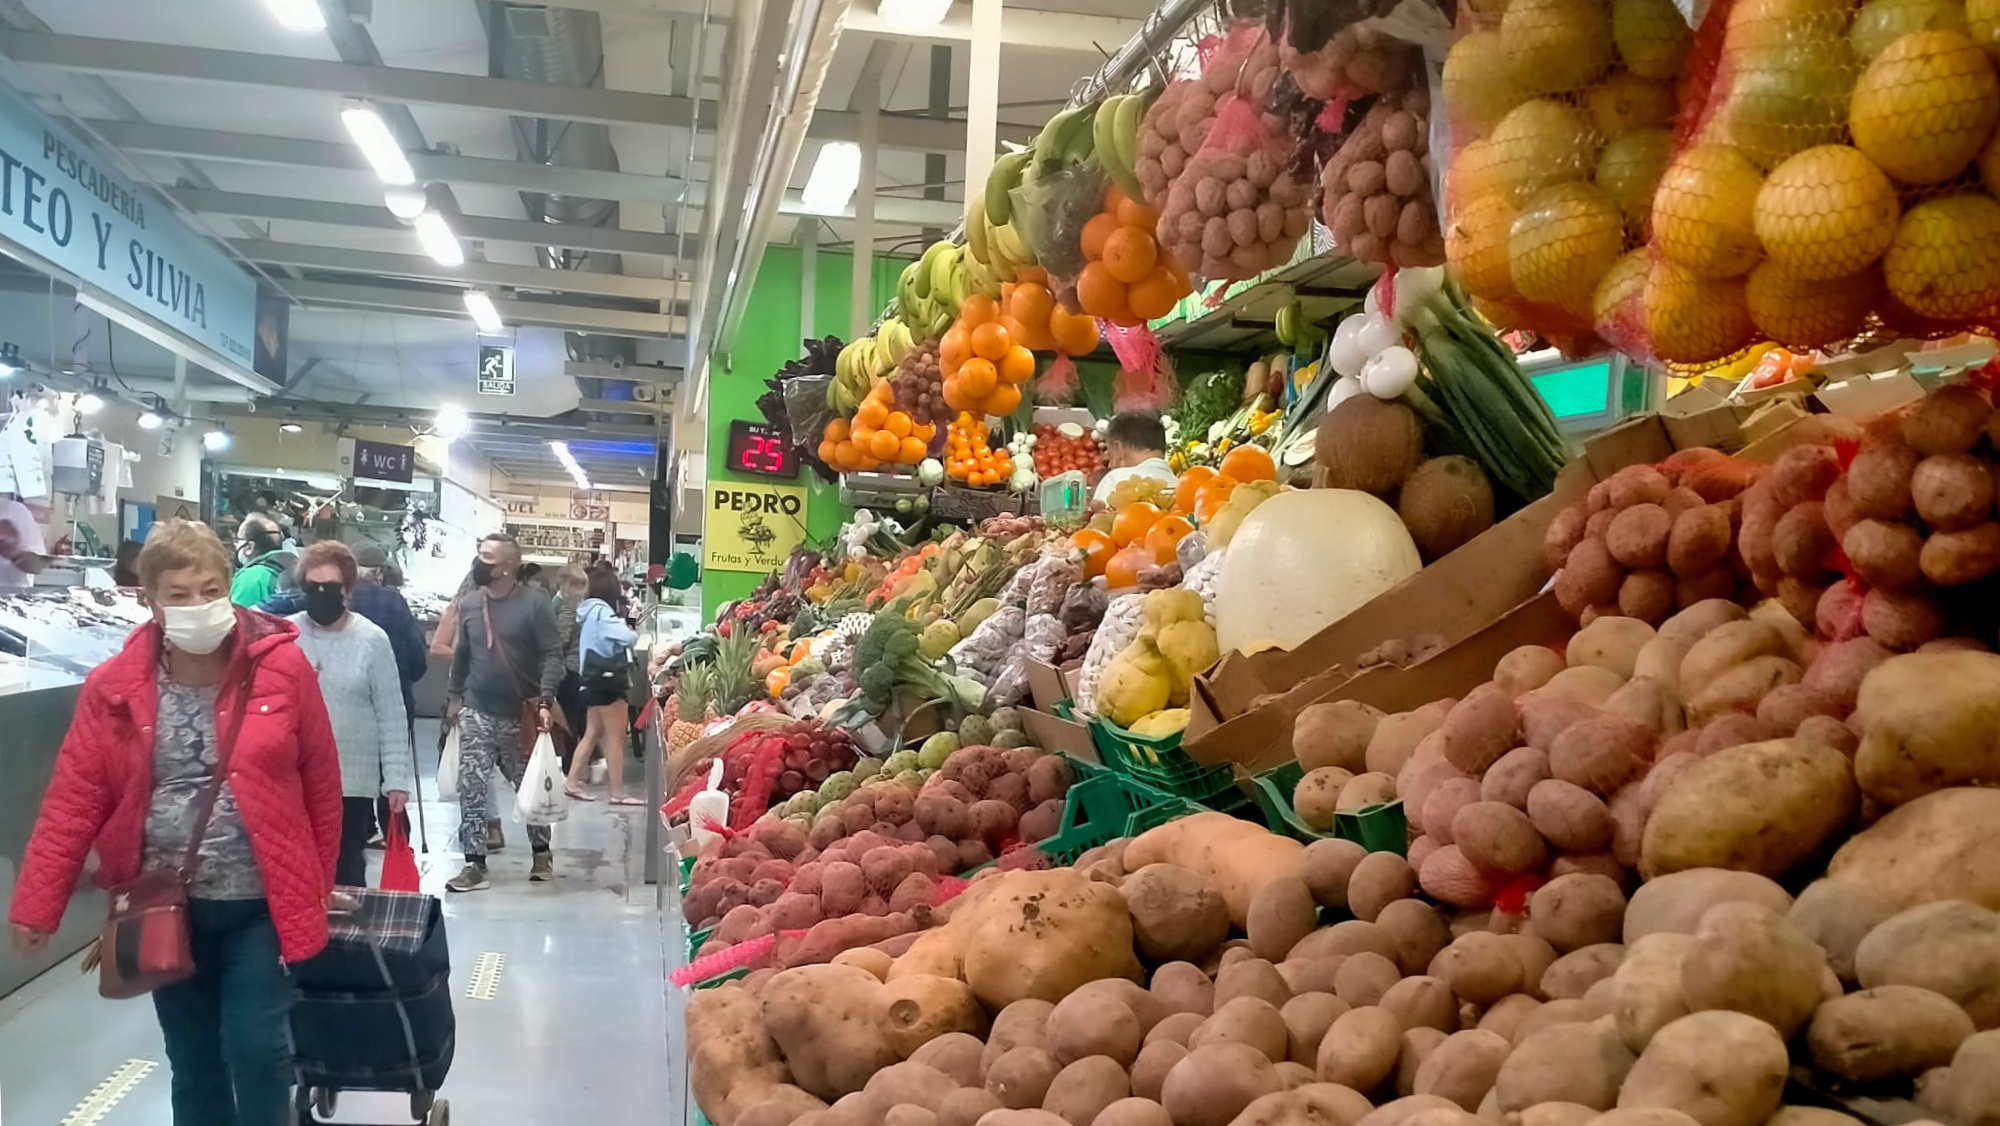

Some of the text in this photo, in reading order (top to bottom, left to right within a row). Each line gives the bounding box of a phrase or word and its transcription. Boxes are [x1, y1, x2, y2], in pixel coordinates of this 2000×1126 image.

[43, 130, 145, 229] PESCADERÍA
[92, 212, 112, 270] Y
[127, 239, 207, 329] SILVIA
[373, 454, 396, 470] WC
[741, 435, 783, 471] 25
[714, 490, 801, 515] PEDRO
[711, 552, 785, 567] Frutas y Verdu
